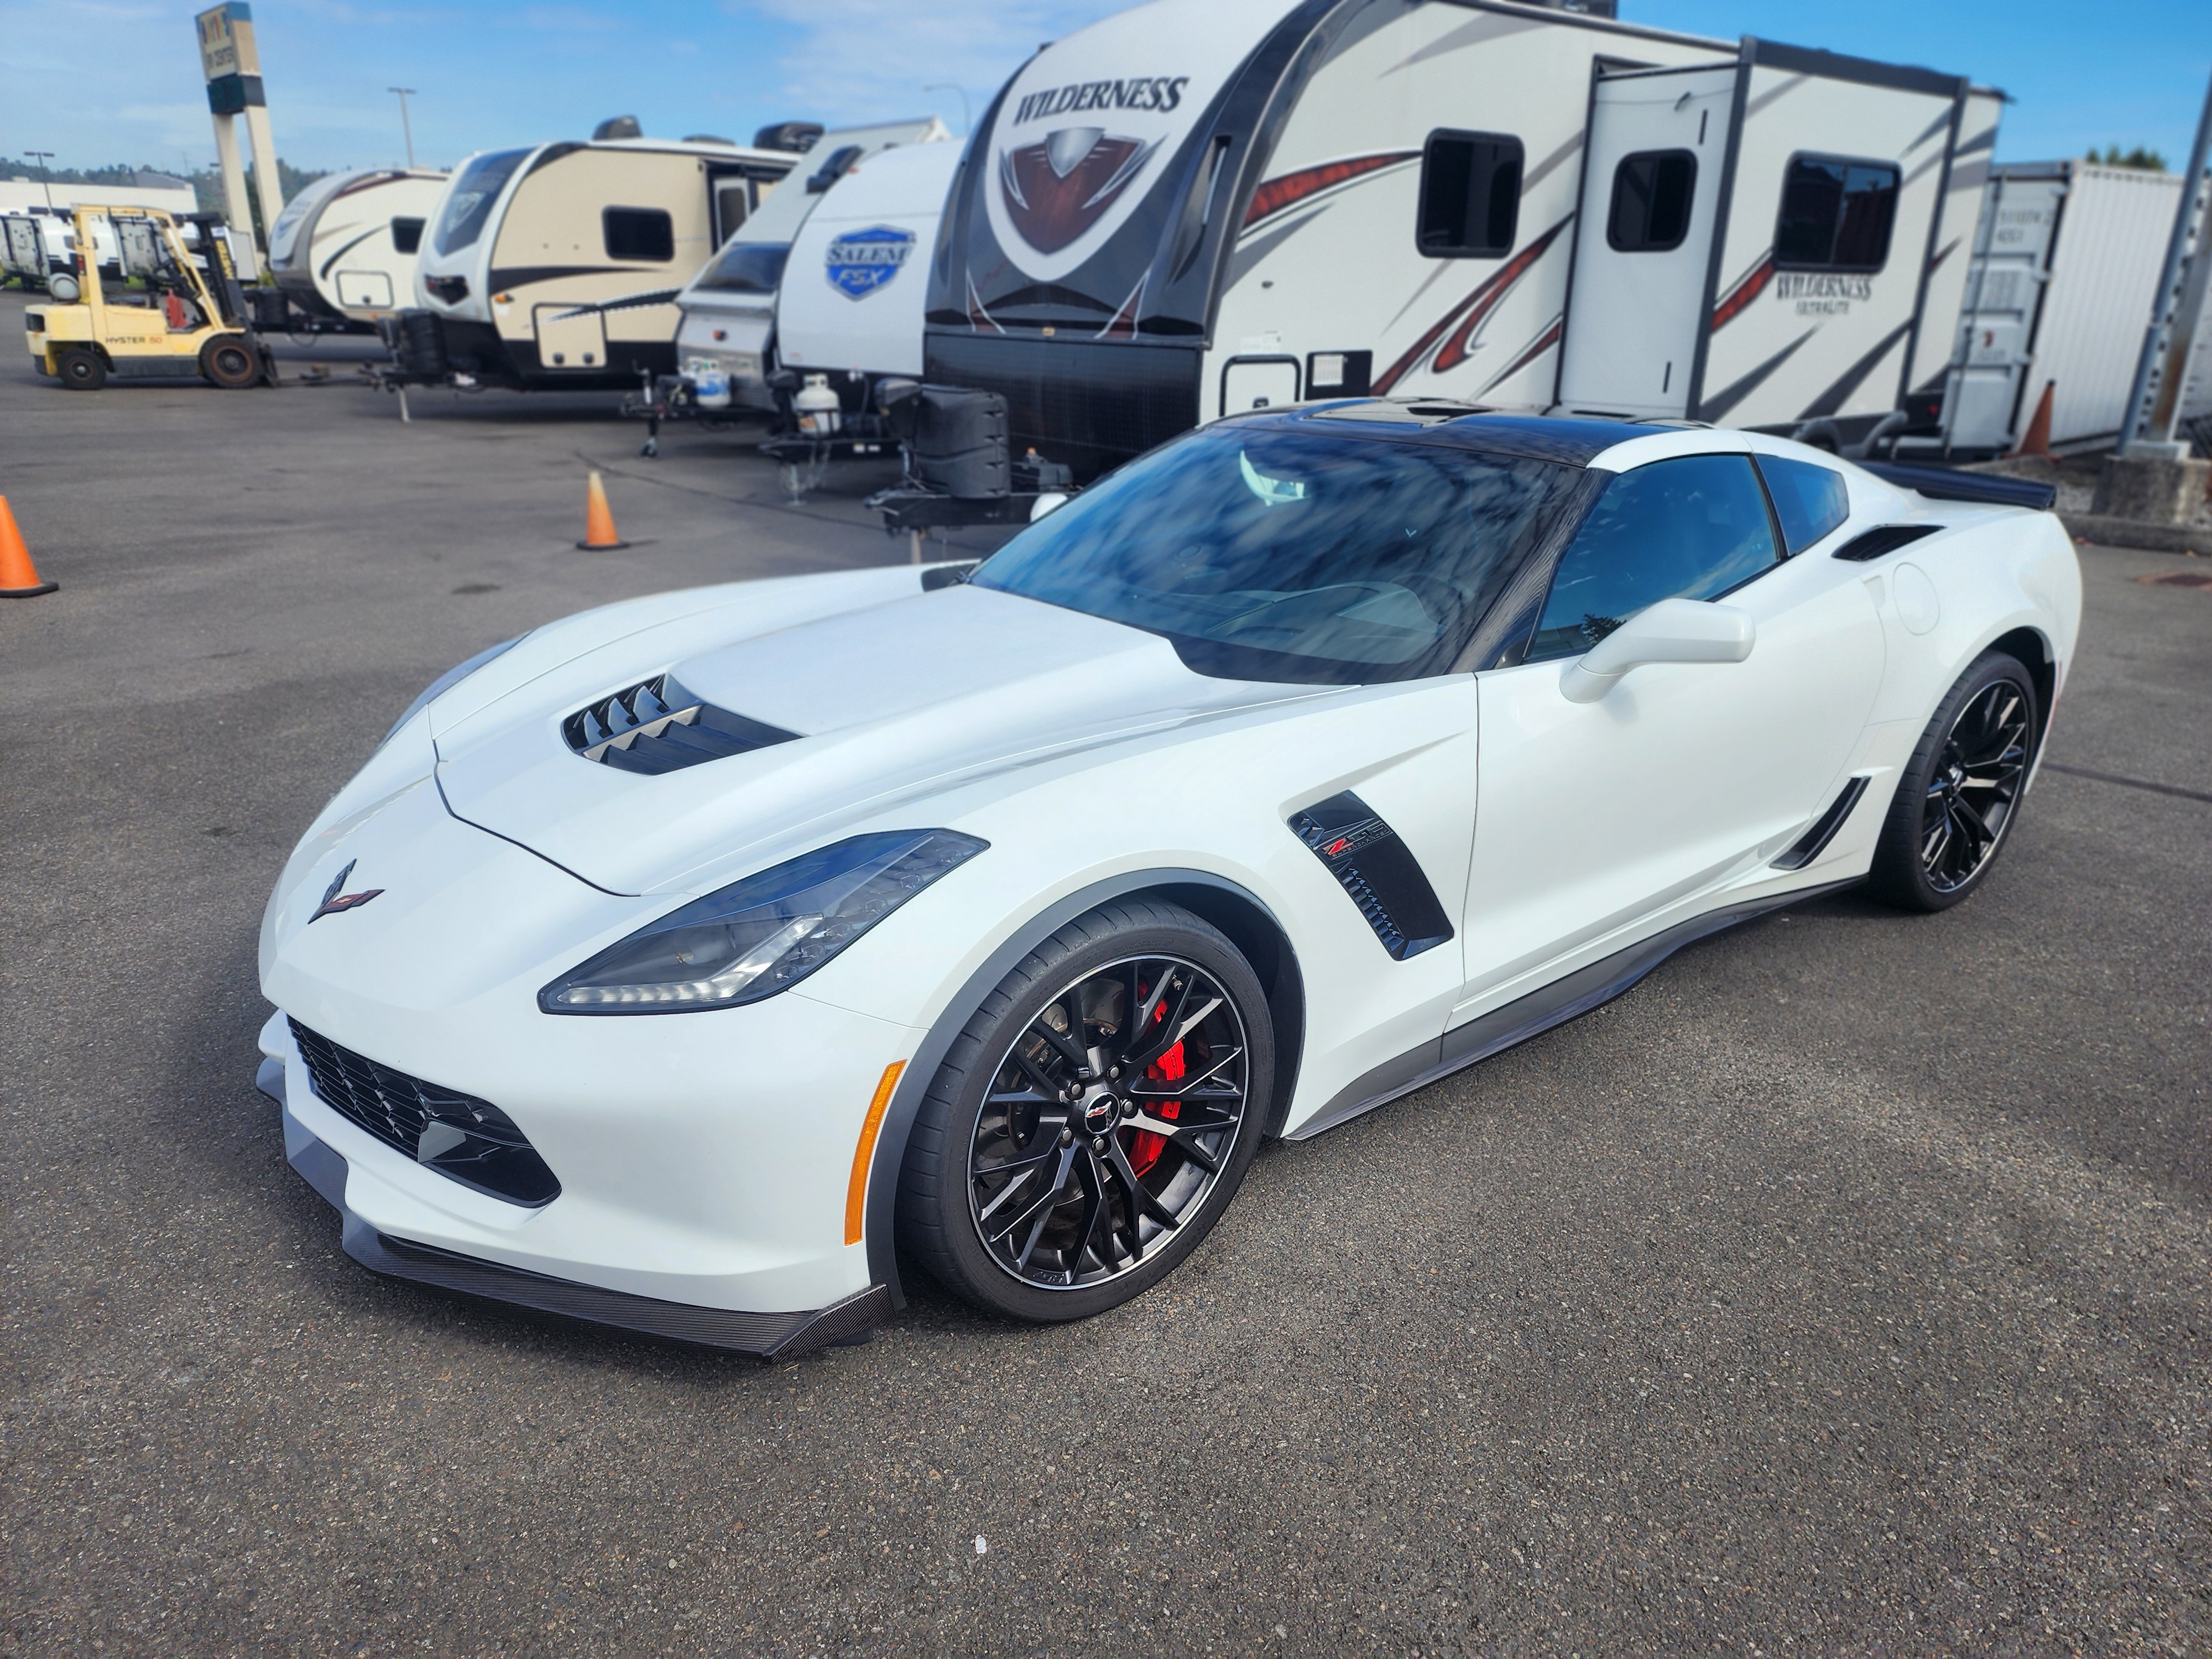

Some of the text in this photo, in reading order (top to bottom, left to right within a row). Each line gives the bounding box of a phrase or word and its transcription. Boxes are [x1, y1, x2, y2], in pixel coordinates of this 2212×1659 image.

[1013, 76, 1190, 126] WILDERNESS
[827, 240, 909, 267] SALEM
[1776, 274, 1872, 301] WILDERNESS
[105, 336, 145, 344] HYSTER
